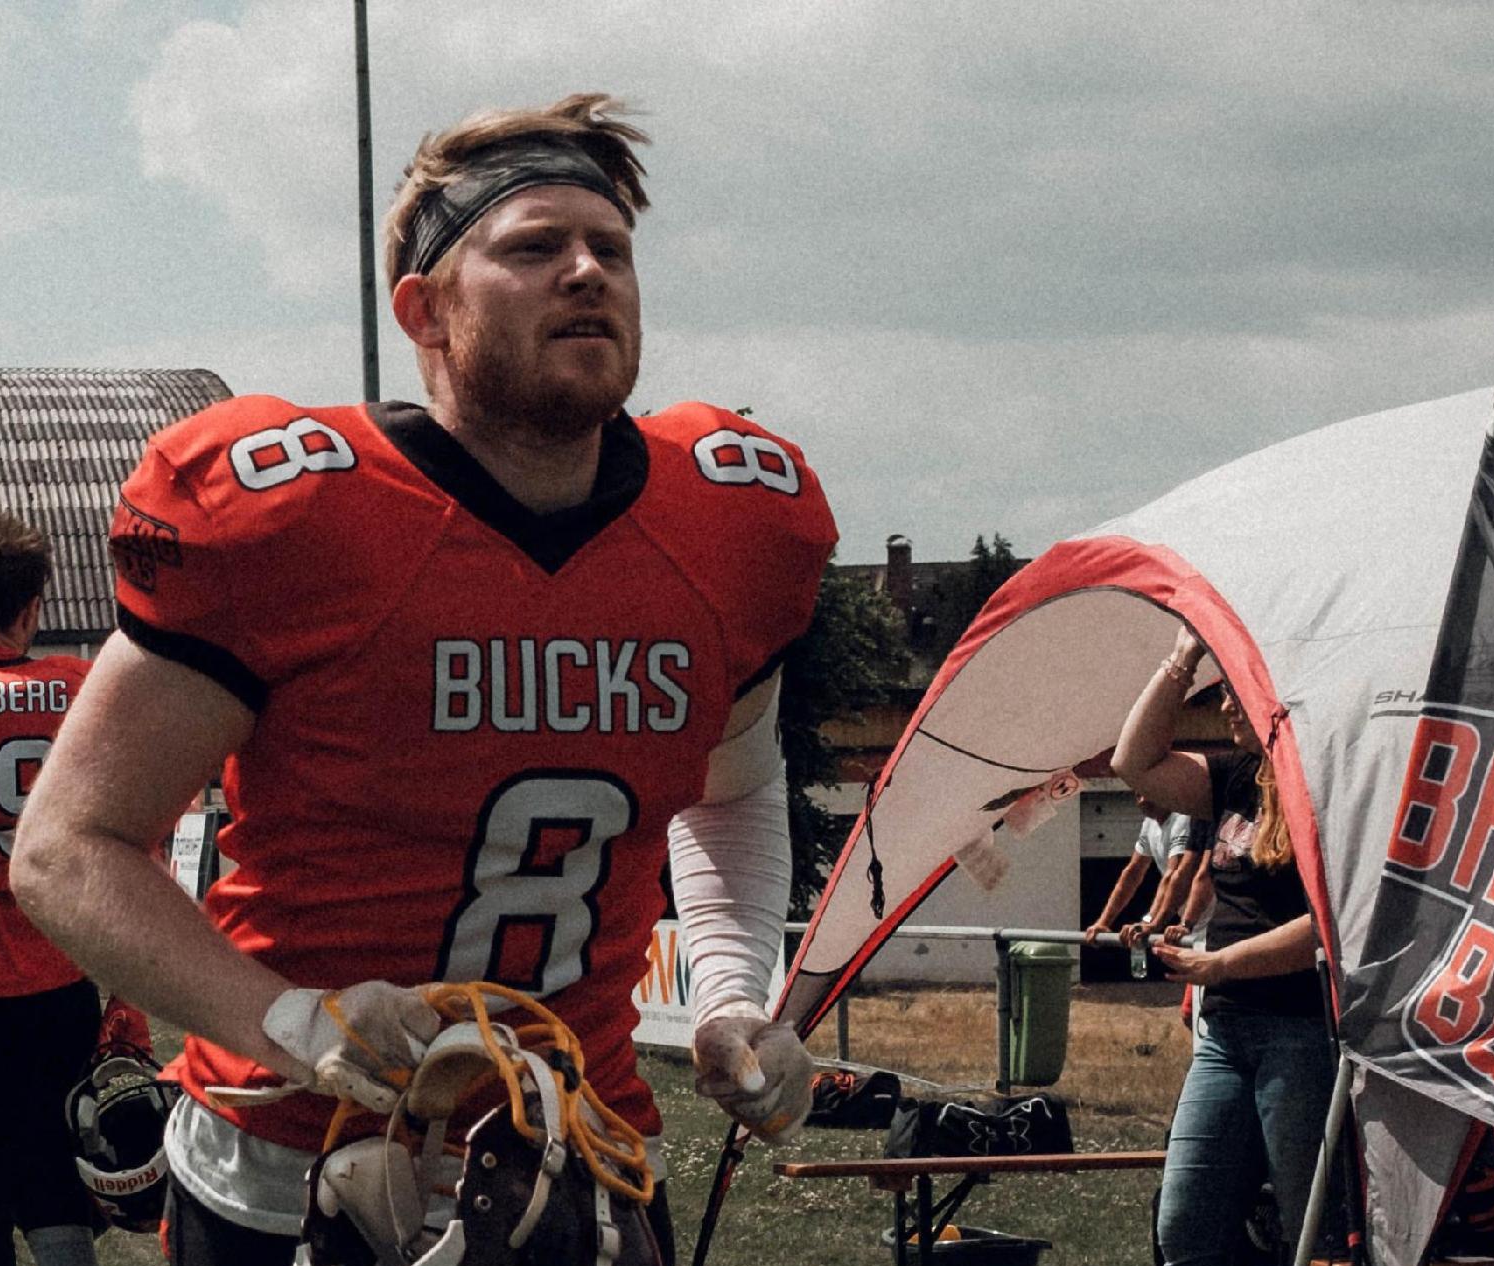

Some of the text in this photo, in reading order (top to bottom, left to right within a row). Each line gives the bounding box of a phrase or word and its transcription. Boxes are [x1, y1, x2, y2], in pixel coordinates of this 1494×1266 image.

[229, 415, 359, 492] 8
[693, 428, 800, 495] 8
[433, 637, 691, 734] BUCKS
[433, 768, 640, 1016] 8
[93, 1168, 158, 1193] Riddell
